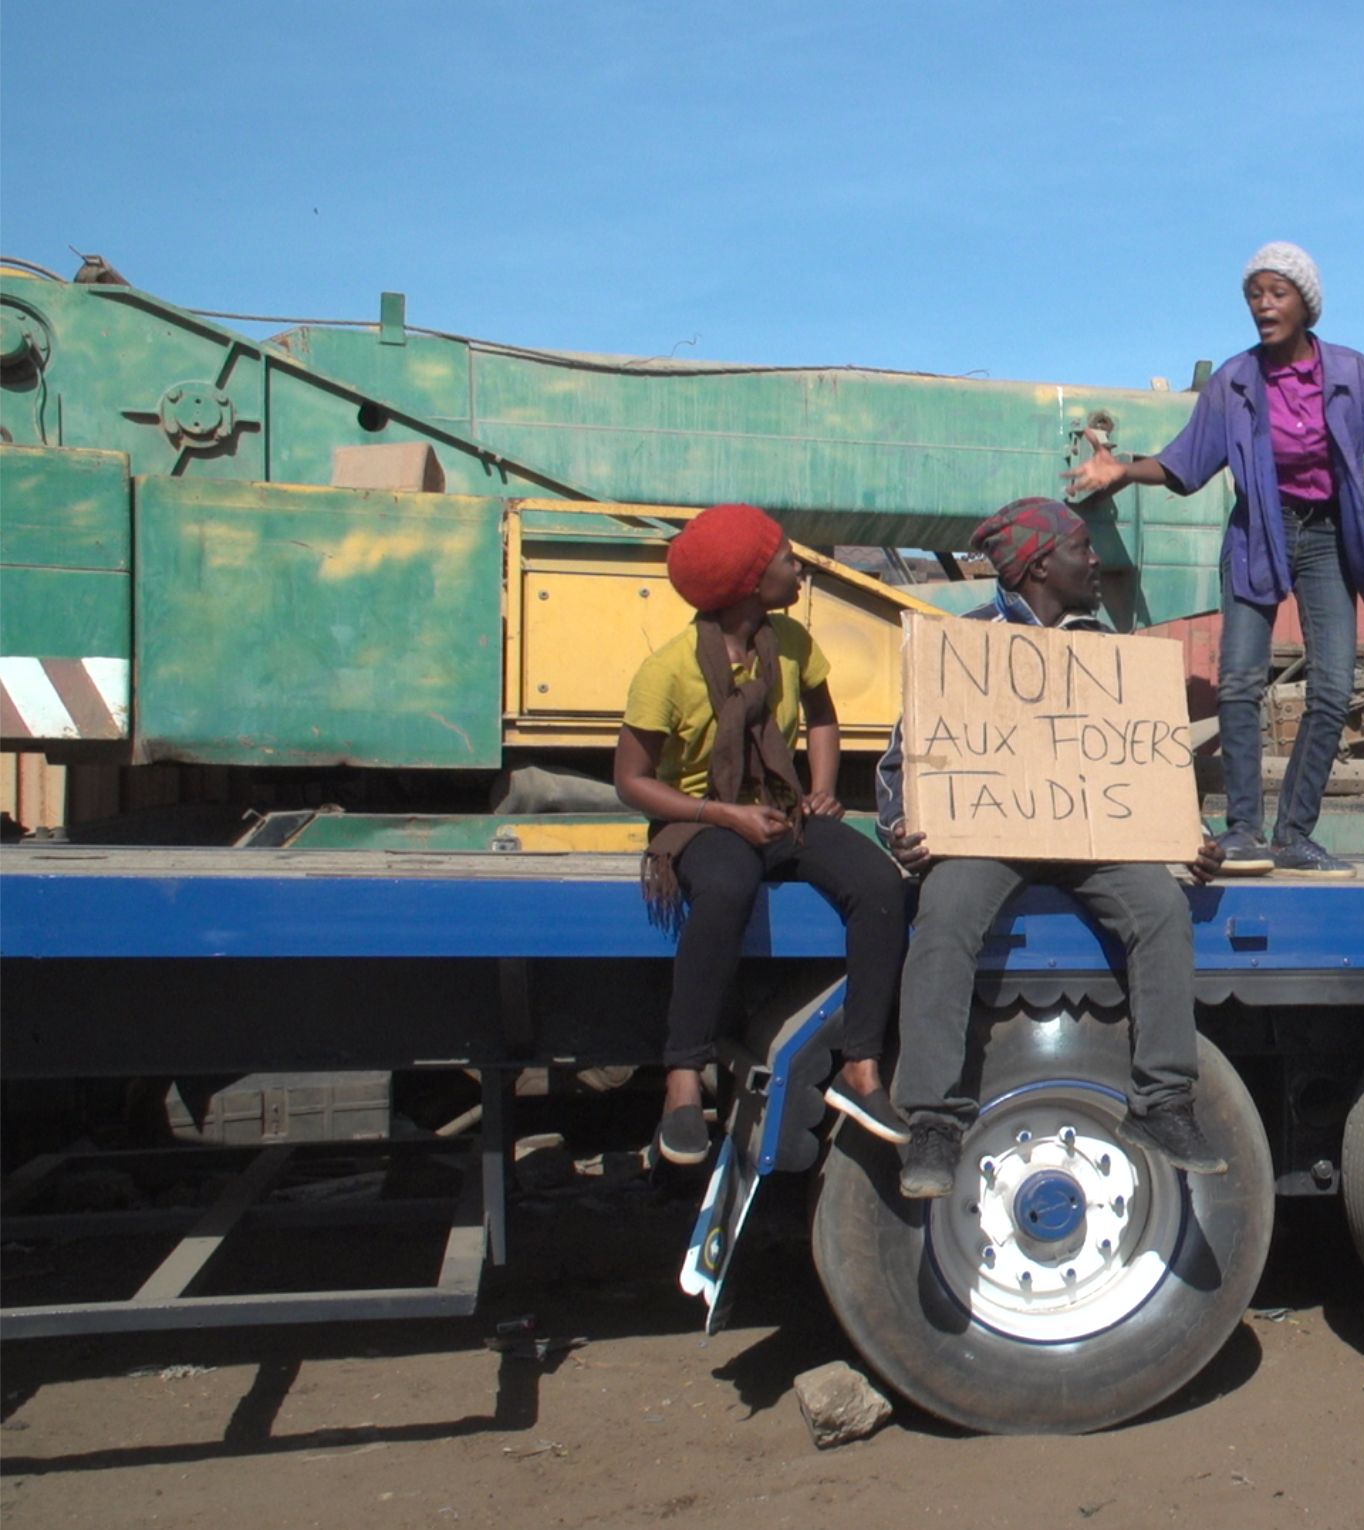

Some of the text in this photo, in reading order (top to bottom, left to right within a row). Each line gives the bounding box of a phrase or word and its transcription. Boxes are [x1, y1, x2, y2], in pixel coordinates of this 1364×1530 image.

[940, 629, 1123, 709] NON
[923, 714, 1194, 768] AUX FOYERS
